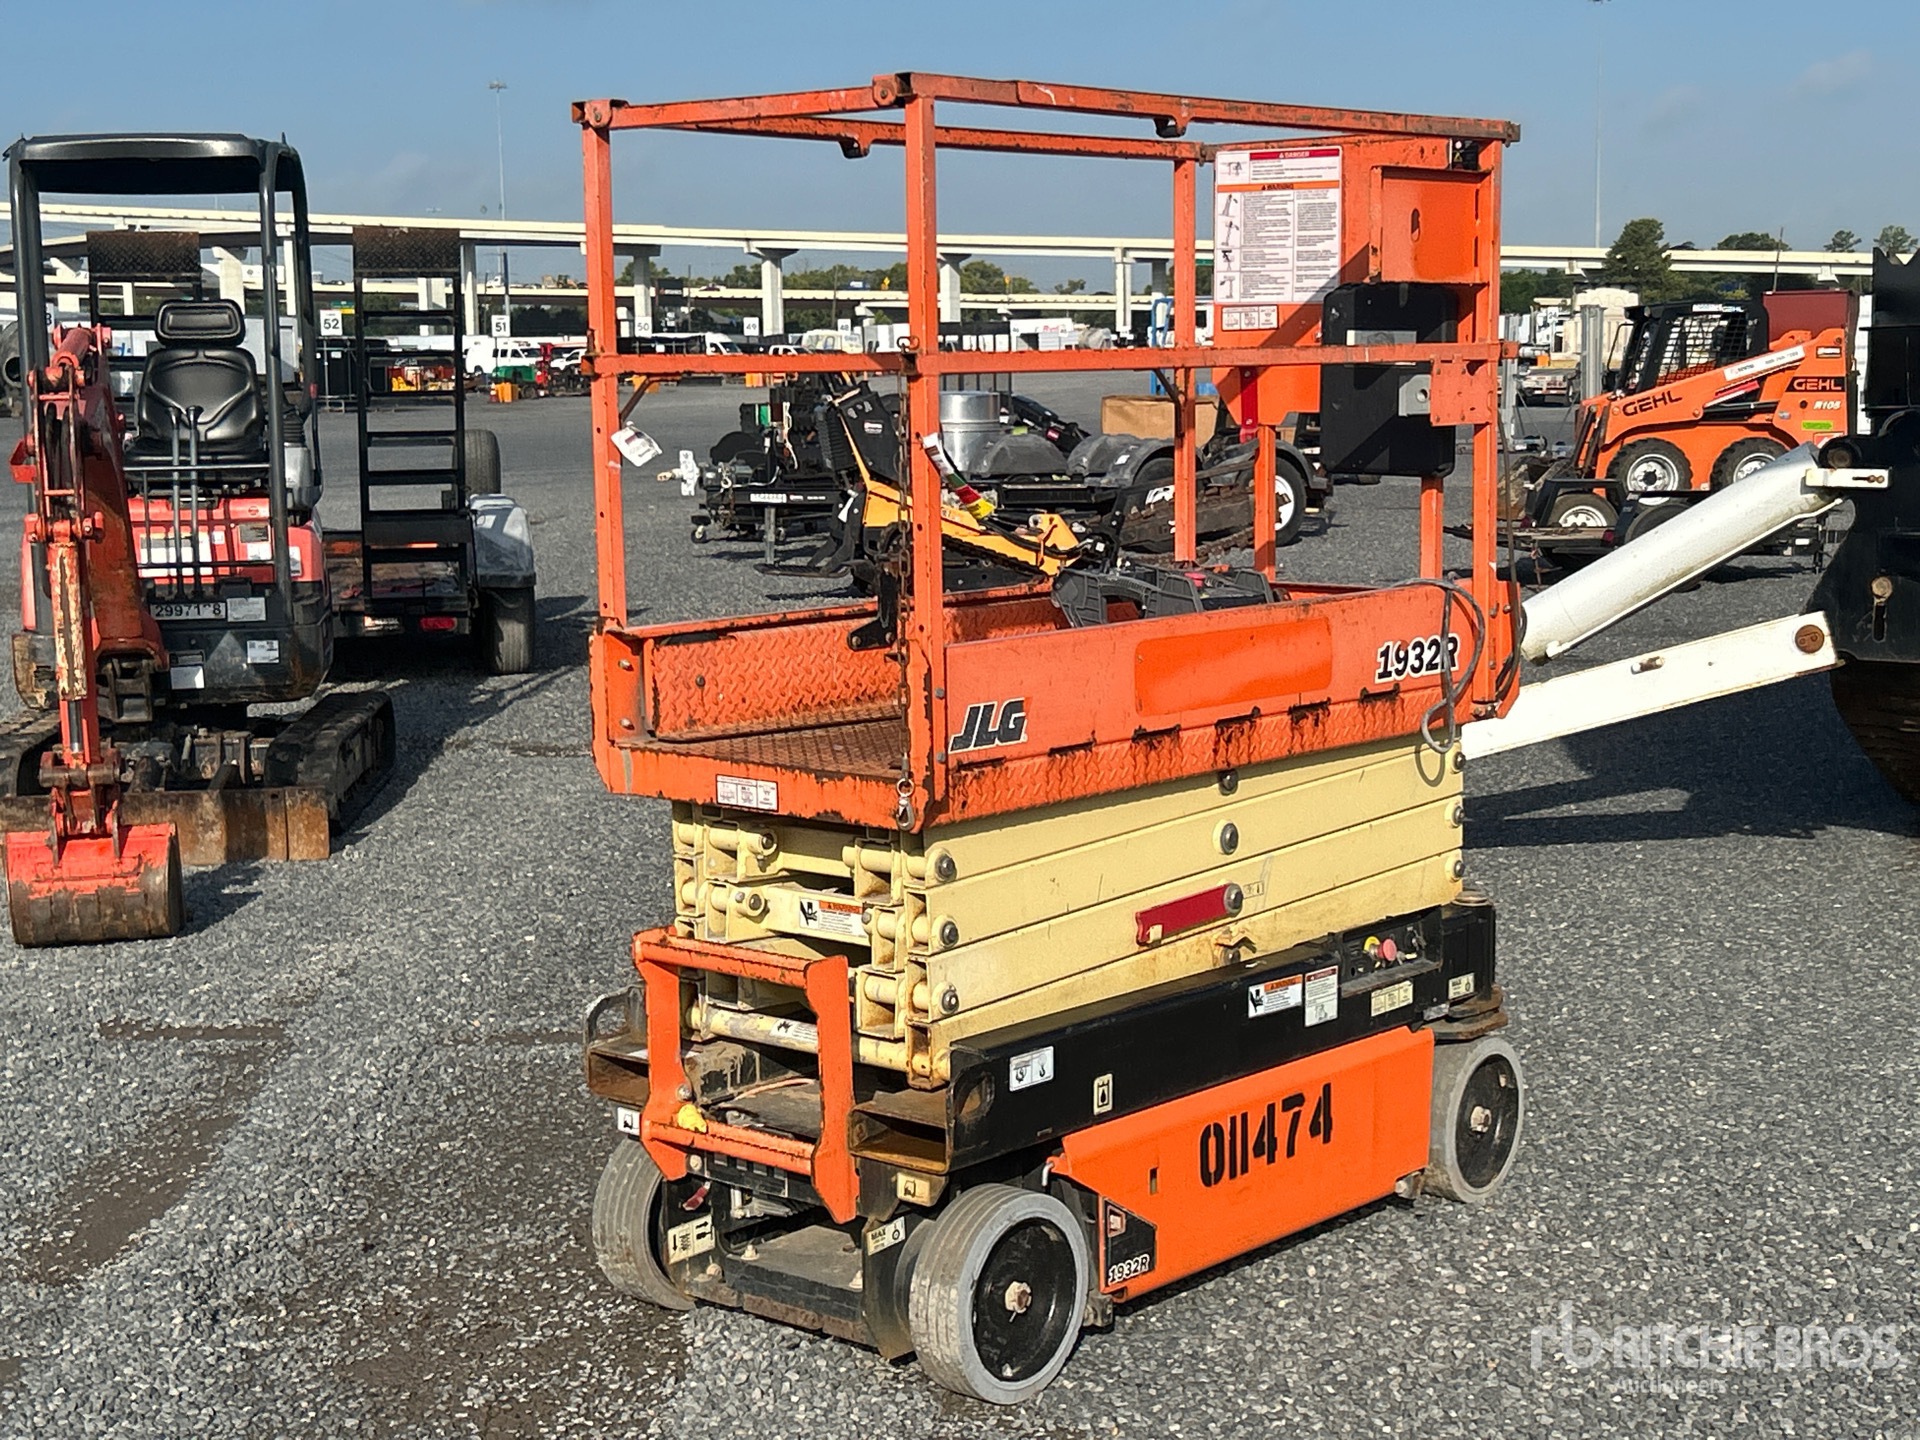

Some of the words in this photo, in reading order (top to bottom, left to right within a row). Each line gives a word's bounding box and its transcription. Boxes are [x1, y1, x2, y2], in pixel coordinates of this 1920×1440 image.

[323, 318, 340, 330] 52
[495, 321, 507, 333] 51
[637, 322, 650, 332] 50
[745, 322, 757, 331] 49
[1793, 378, 1842, 390] GEHL
[1622, 391, 1683, 417] GEHL
[155, 603, 222, 618] 299718
[1375, 635, 1460, 681] 1932R
[949, 697, 1028, 753] JLG
[1200, 1082, 1333, 1188] 011474
[870, 1227, 886, 1241] MAX
[1108, 1255, 1150, 1285] 1932R
